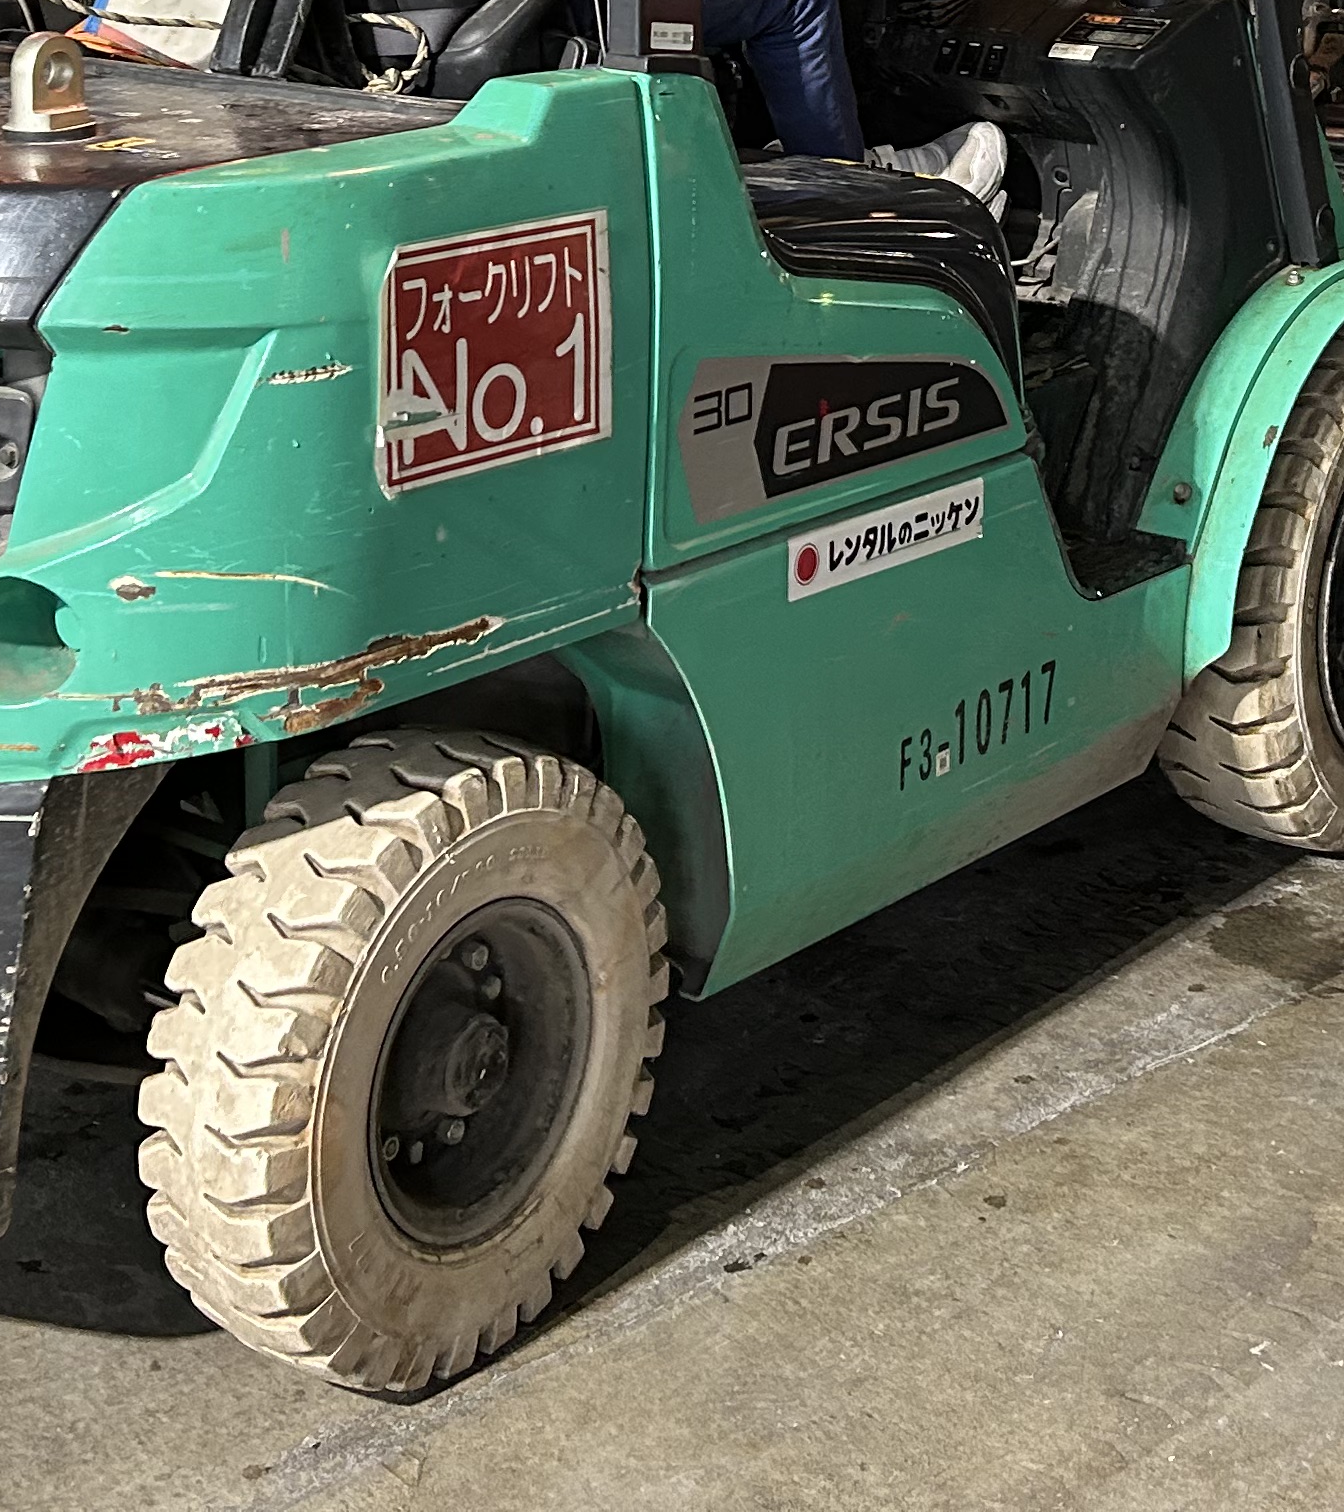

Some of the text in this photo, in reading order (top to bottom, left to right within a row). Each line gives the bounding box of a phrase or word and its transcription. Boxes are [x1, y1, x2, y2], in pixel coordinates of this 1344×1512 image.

[402, 246, 583, 341] フォークリフト
[693, 381, 753, 436] 30
[772, 376, 960, 476] ERSIS
[828, 495, 981, 572] レンタルのニッケン
[899, 658, 1057, 792] F3-10717
